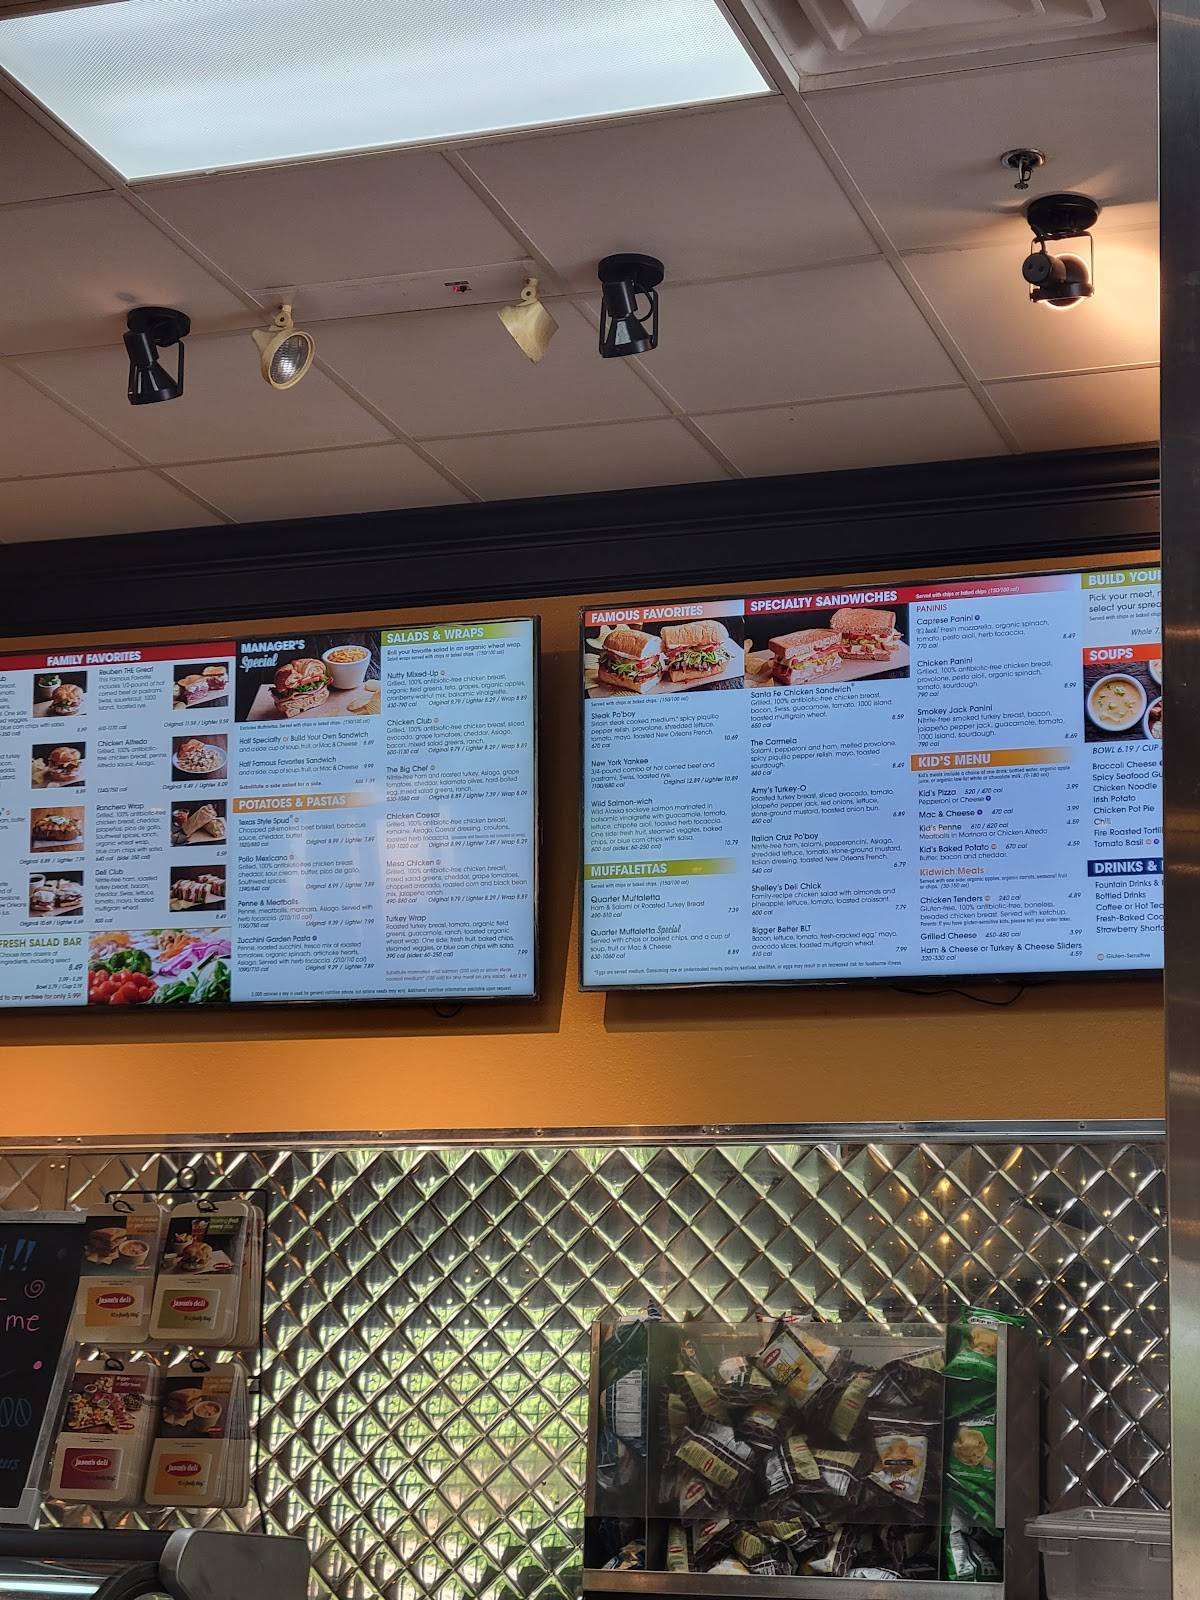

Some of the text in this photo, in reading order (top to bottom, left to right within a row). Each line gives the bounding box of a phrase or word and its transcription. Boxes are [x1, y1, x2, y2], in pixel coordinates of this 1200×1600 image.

[1088, 570, 1160, 585] BUILD YOU
[1130, 590, 1154, 598] meat,
[751, 591, 897, 611] SPECIALTY SANDWICHES
[916, 604, 947, 612] PANINIS
[591, 606, 703, 623] FAMOUS FAVORITES
[917, 616, 948, 627] Caprese
[387, 628, 484, 643] SALADS & WRAPS
[241, 640, 305, 653] MANAGER'S
[47, 651, 141, 666] FAMILY FAVORITES
[1089, 648, 1133, 661] SOUPS
[240, 655, 278, 672] Special
[951, 657, 973, 665] Panini
[407, 670, 438, 678] Mixed-Up
[784, 688, 814, 696] Chicken
[816, 686, 851, 694] Sandwich
[918, 708, 946, 716] Smokey
[918, 753, 991, 768] KID'S MENU
[413, 764, 429, 772] Chef
[1116, 772, 1149, 780] Seafood
[752, 785, 806, 794] Amy's Turkey-O
[1093, 784, 1125, 792] Chicken
[239, 795, 345, 809] POTATOES & PASTAS
[608, 798, 652, 806] Salmon-wich
[1094, 806, 1126, 814] Chicken
[794, 832, 818, 841] Po'boy
[1094, 840, 1123, 848] Tomato
[591, 864, 667, 876] MUFFALETTAS
[1095, 860, 1157, 873] DRINKS &
[920, 867, 984, 876] Kidwich Meals
[752, 884, 782, 892] Shelley's
[1095, 881, 1127, 889] Fountain
[921, 896, 951, 904] Chicken
[1096, 892, 1122, 900] Bottled
[1096, 903, 1122, 911] Coffee
[1096, 914, 1144, 922] Fresh-Baked
[591, 929, 617, 937] Quarter
[752, 926, 775, 935] Bigger
[0, 938, 81, 949] FRESH SALAD BAR
[991, 944, 1015, 952] Turkey
